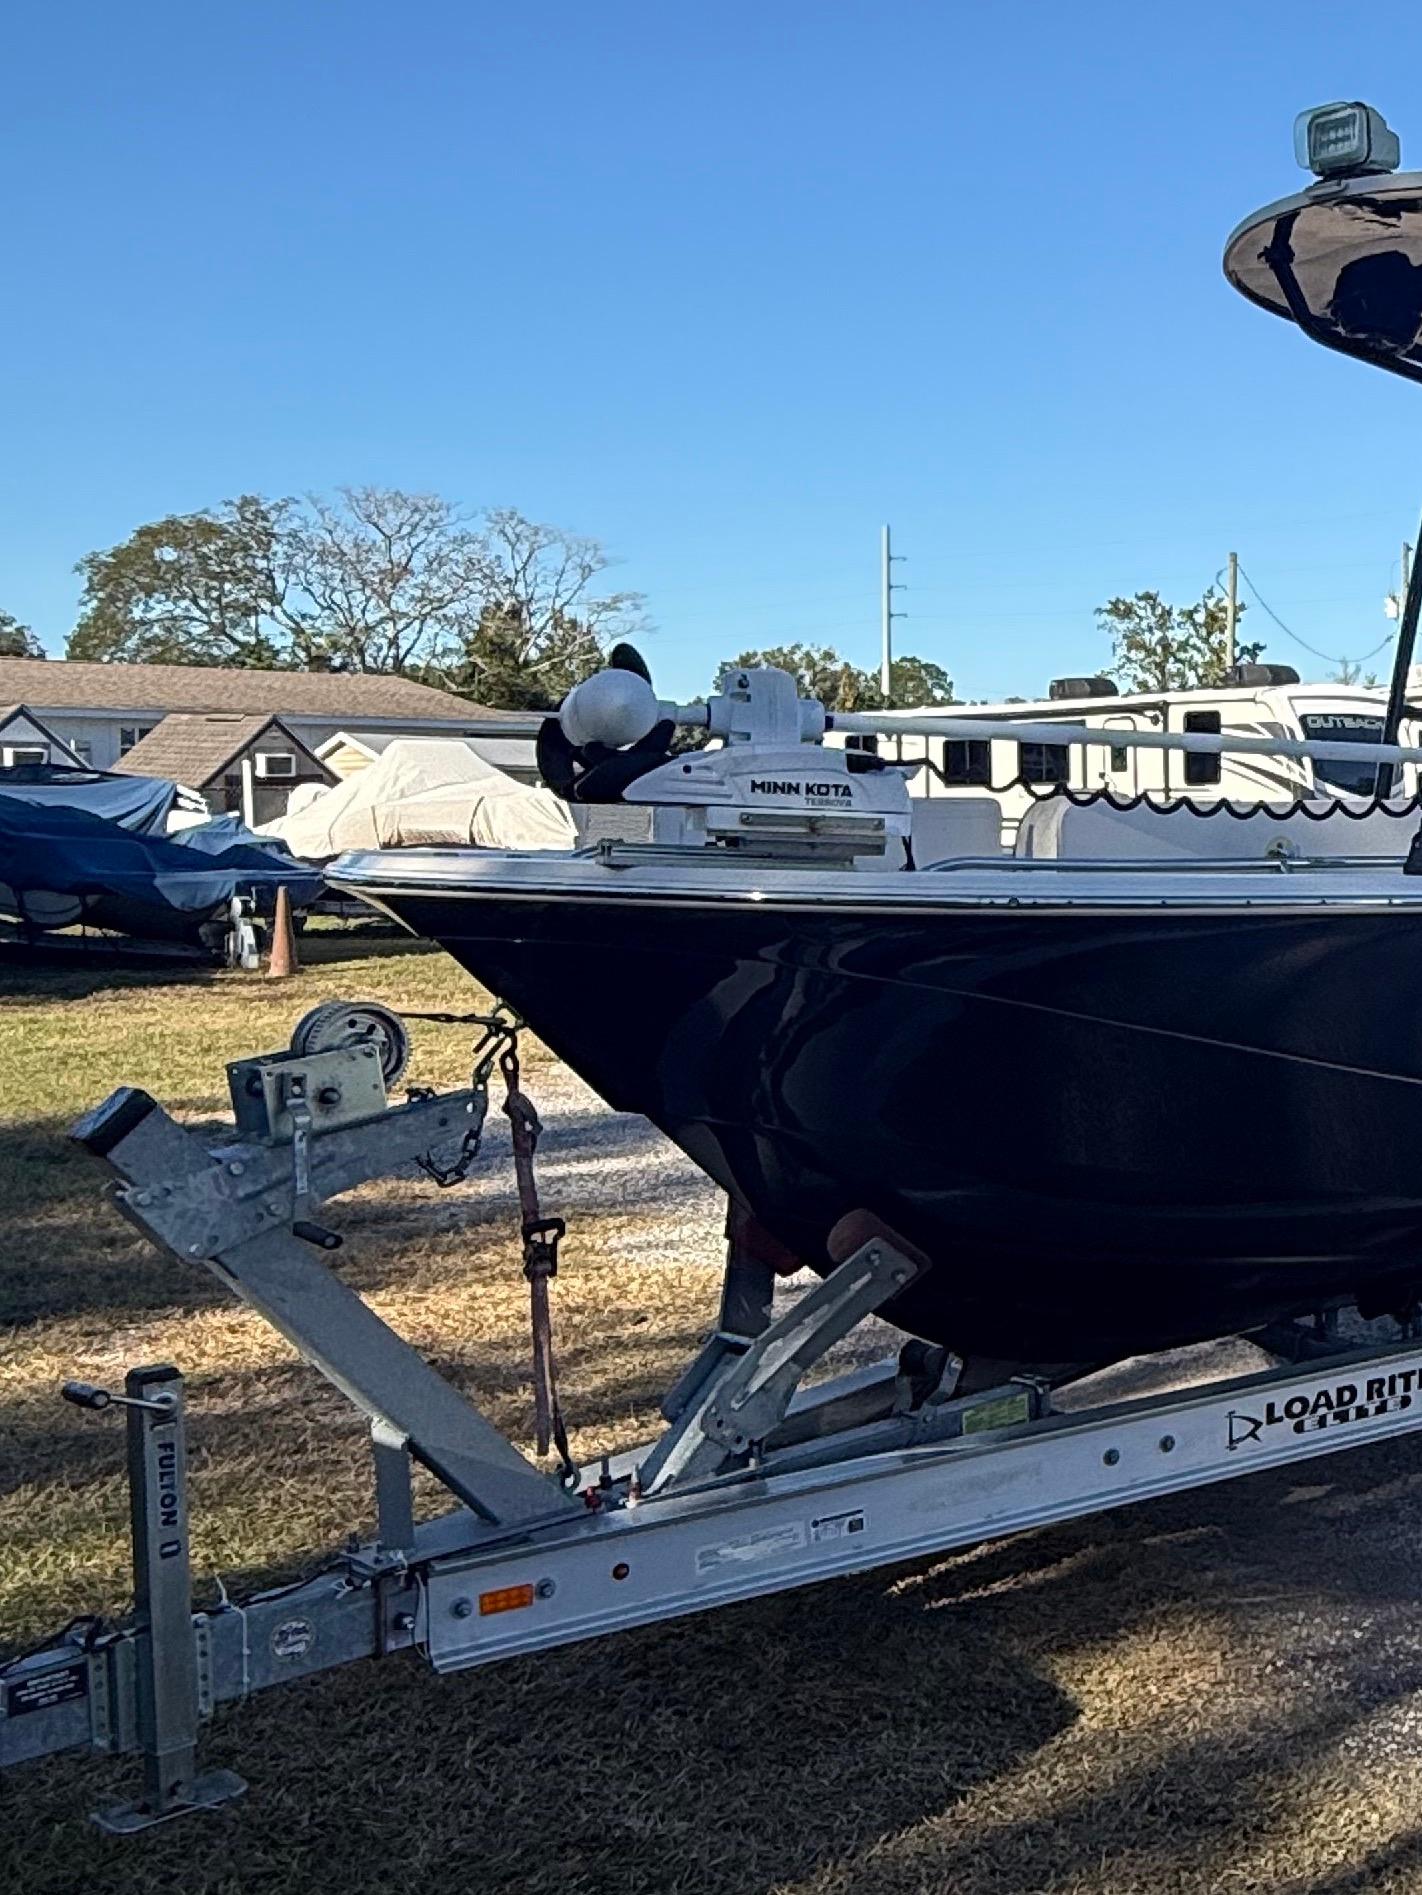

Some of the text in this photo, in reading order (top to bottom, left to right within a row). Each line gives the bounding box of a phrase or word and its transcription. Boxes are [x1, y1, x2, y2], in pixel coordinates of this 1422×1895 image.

[750, 779, 853, 797] MINN KOTA
[1266, 1384, 1357, 1425] LOAD
[158, 1442, 178, 1527] FULTON
